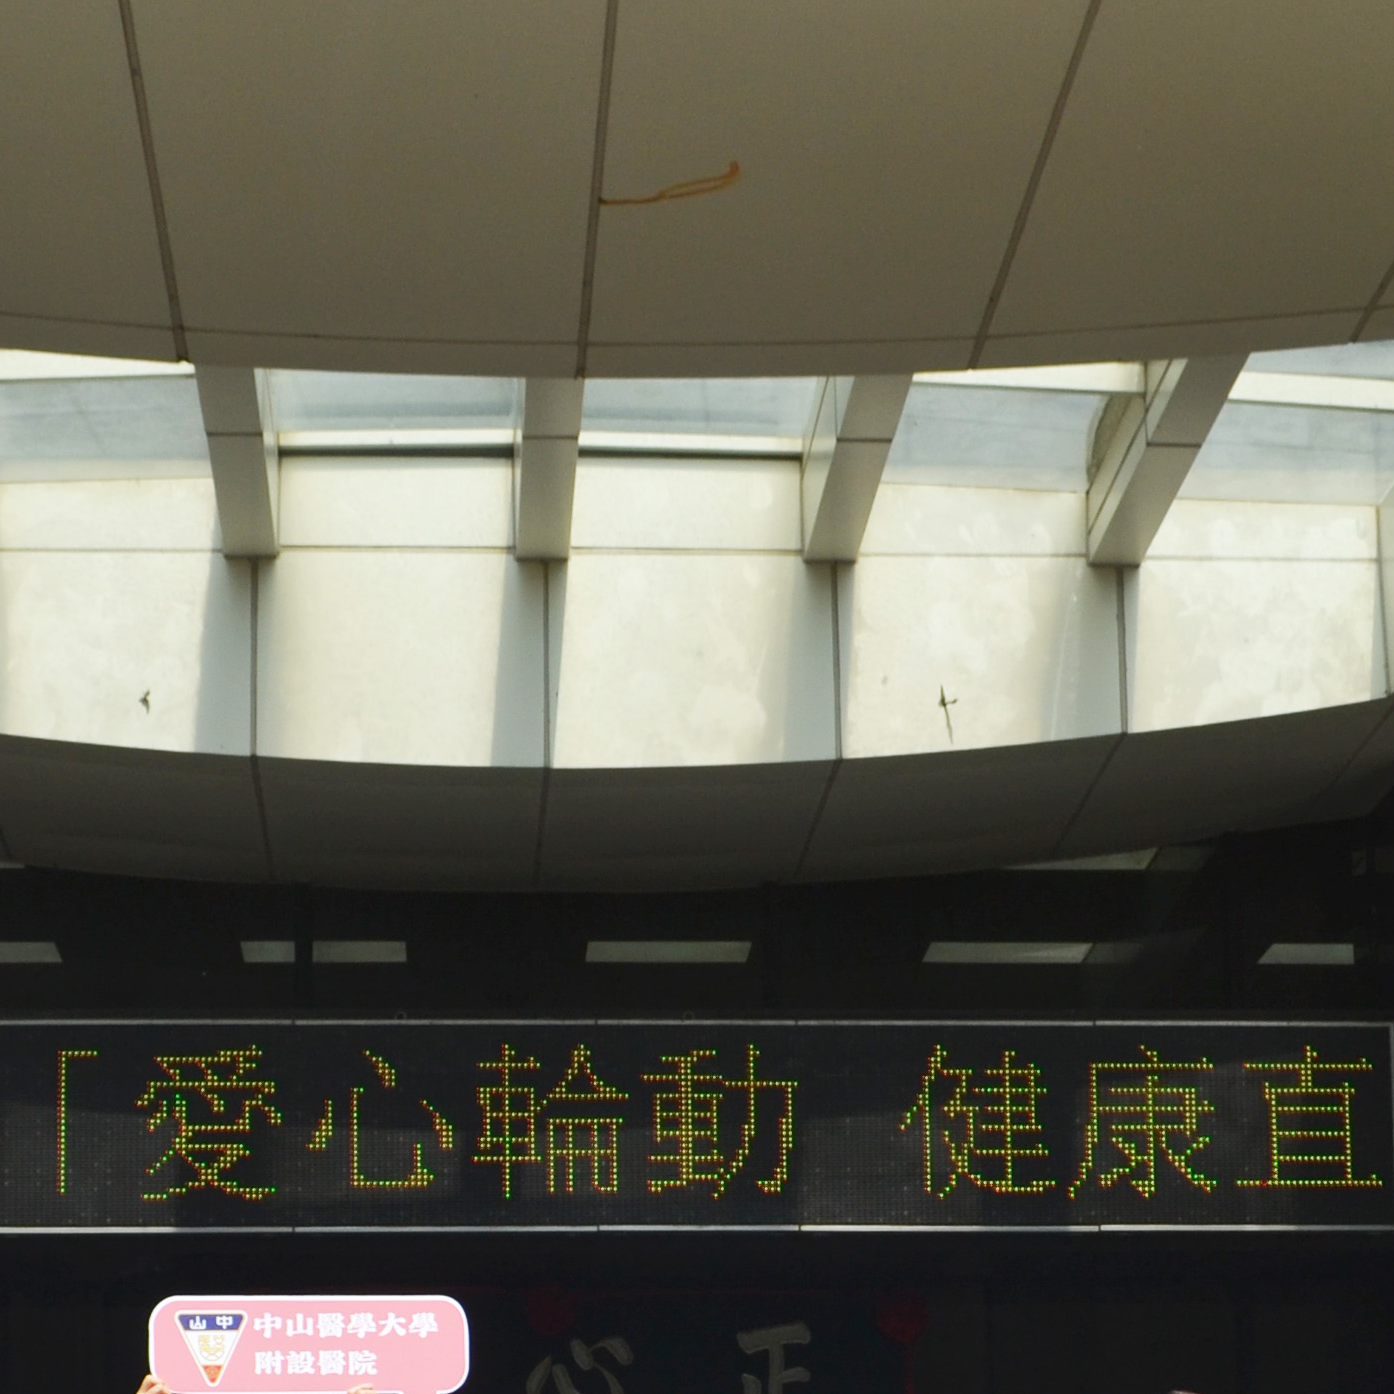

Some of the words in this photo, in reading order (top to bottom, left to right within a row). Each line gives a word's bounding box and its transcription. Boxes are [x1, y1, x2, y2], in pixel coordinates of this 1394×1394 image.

[900, 1044, 1384, 1200] 健康直
[253, 1312, 439, 1339] 中山醫學大學
[255, 1350, 378, 1375] 附設醫院
